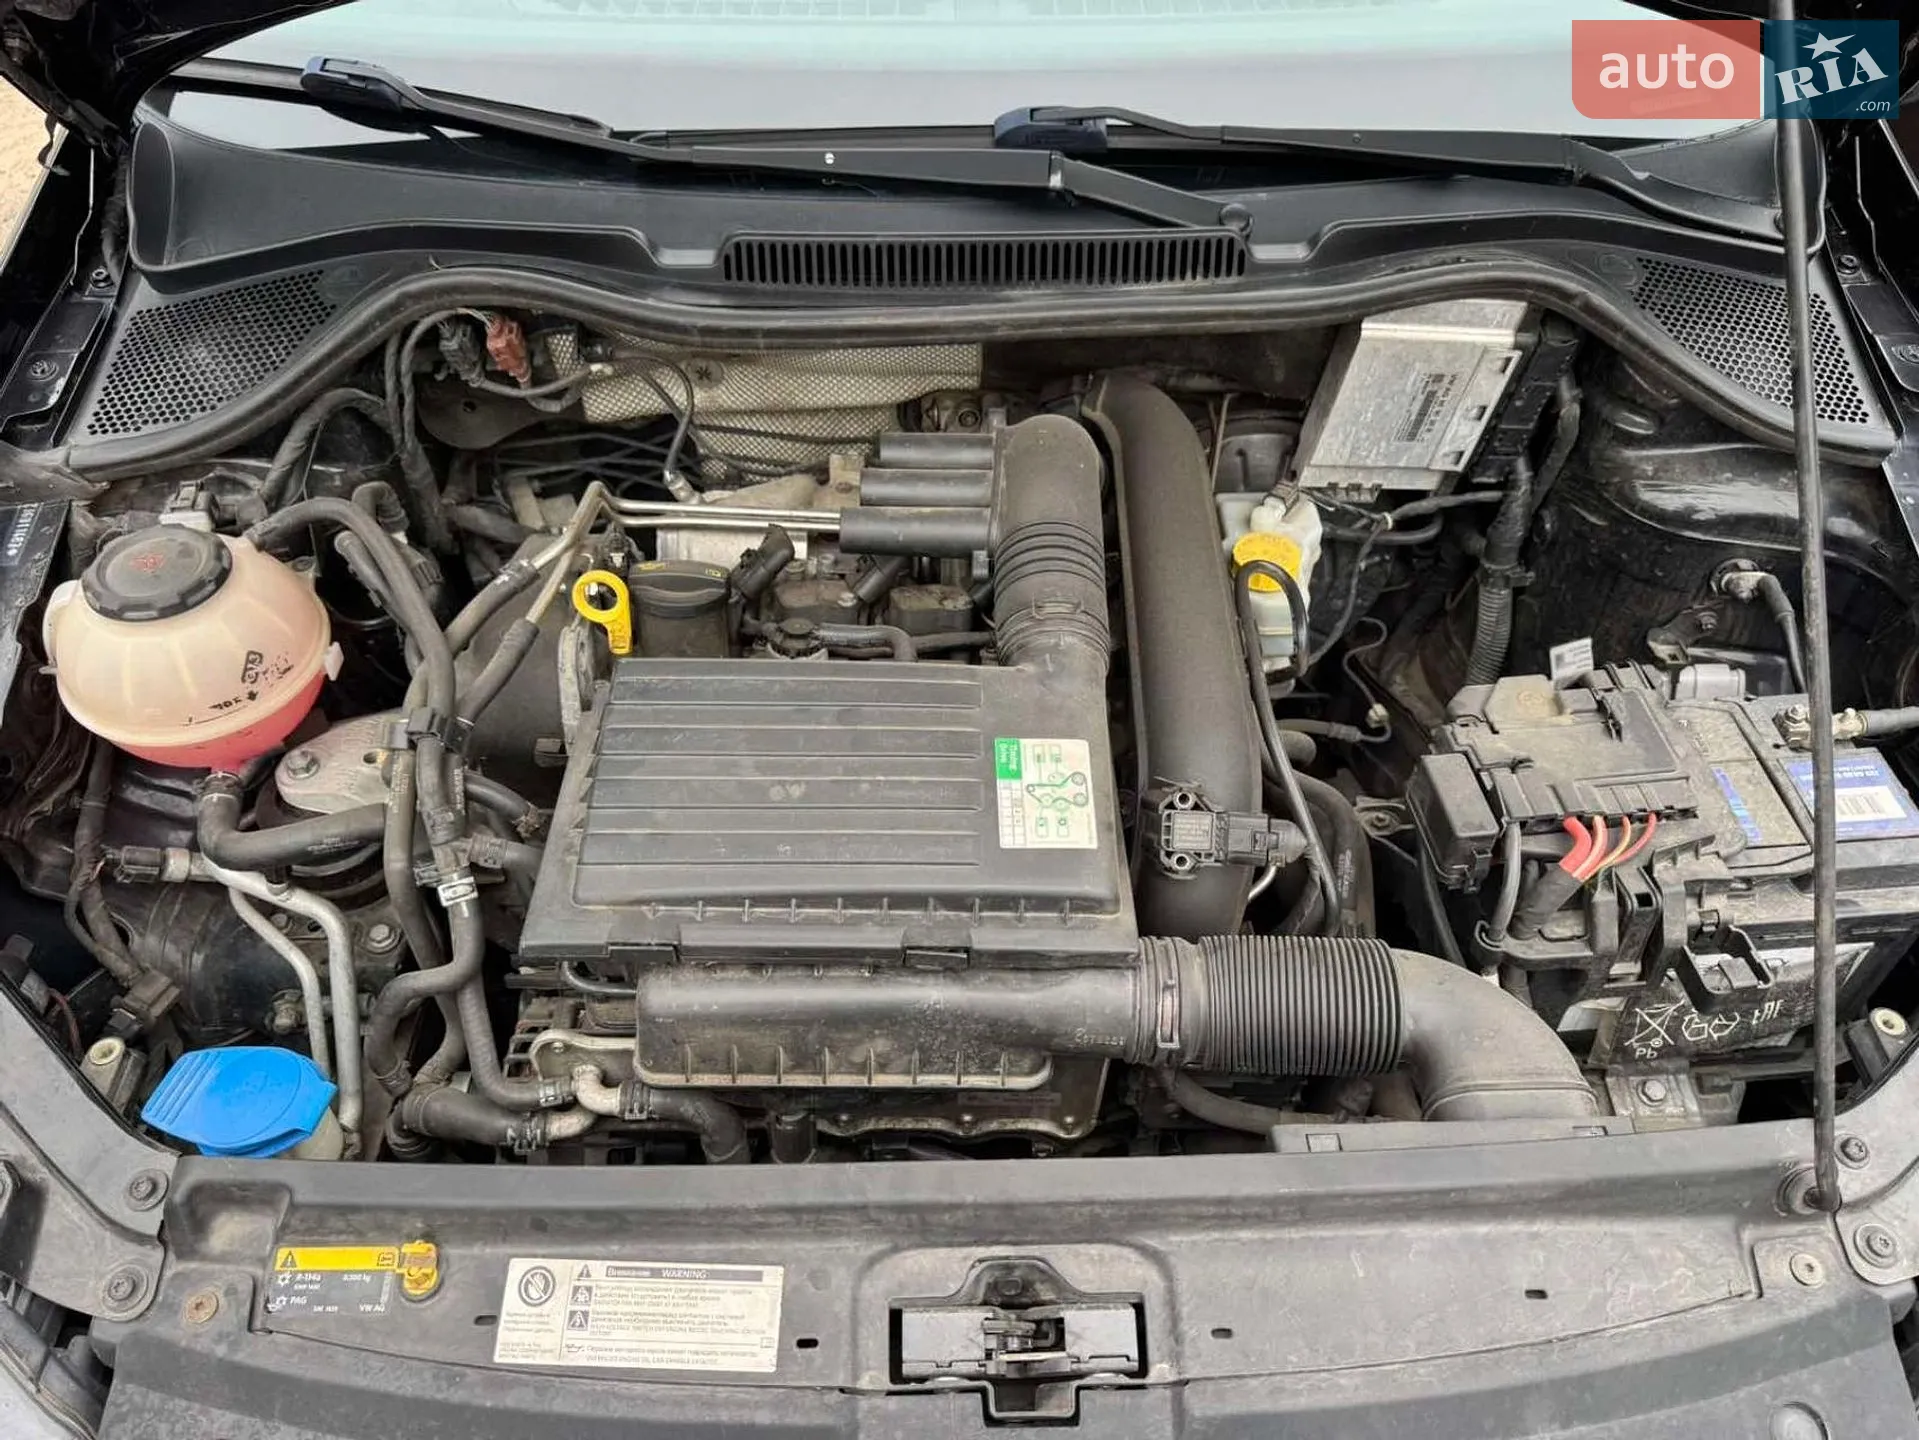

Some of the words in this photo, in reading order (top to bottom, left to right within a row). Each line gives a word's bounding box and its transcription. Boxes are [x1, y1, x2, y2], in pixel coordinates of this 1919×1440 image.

[1635, 1048, 1658, 1060] Pb
[660, 1267, 710, 1280] WARNING
[290, 1296, 308, 1305] PAG
